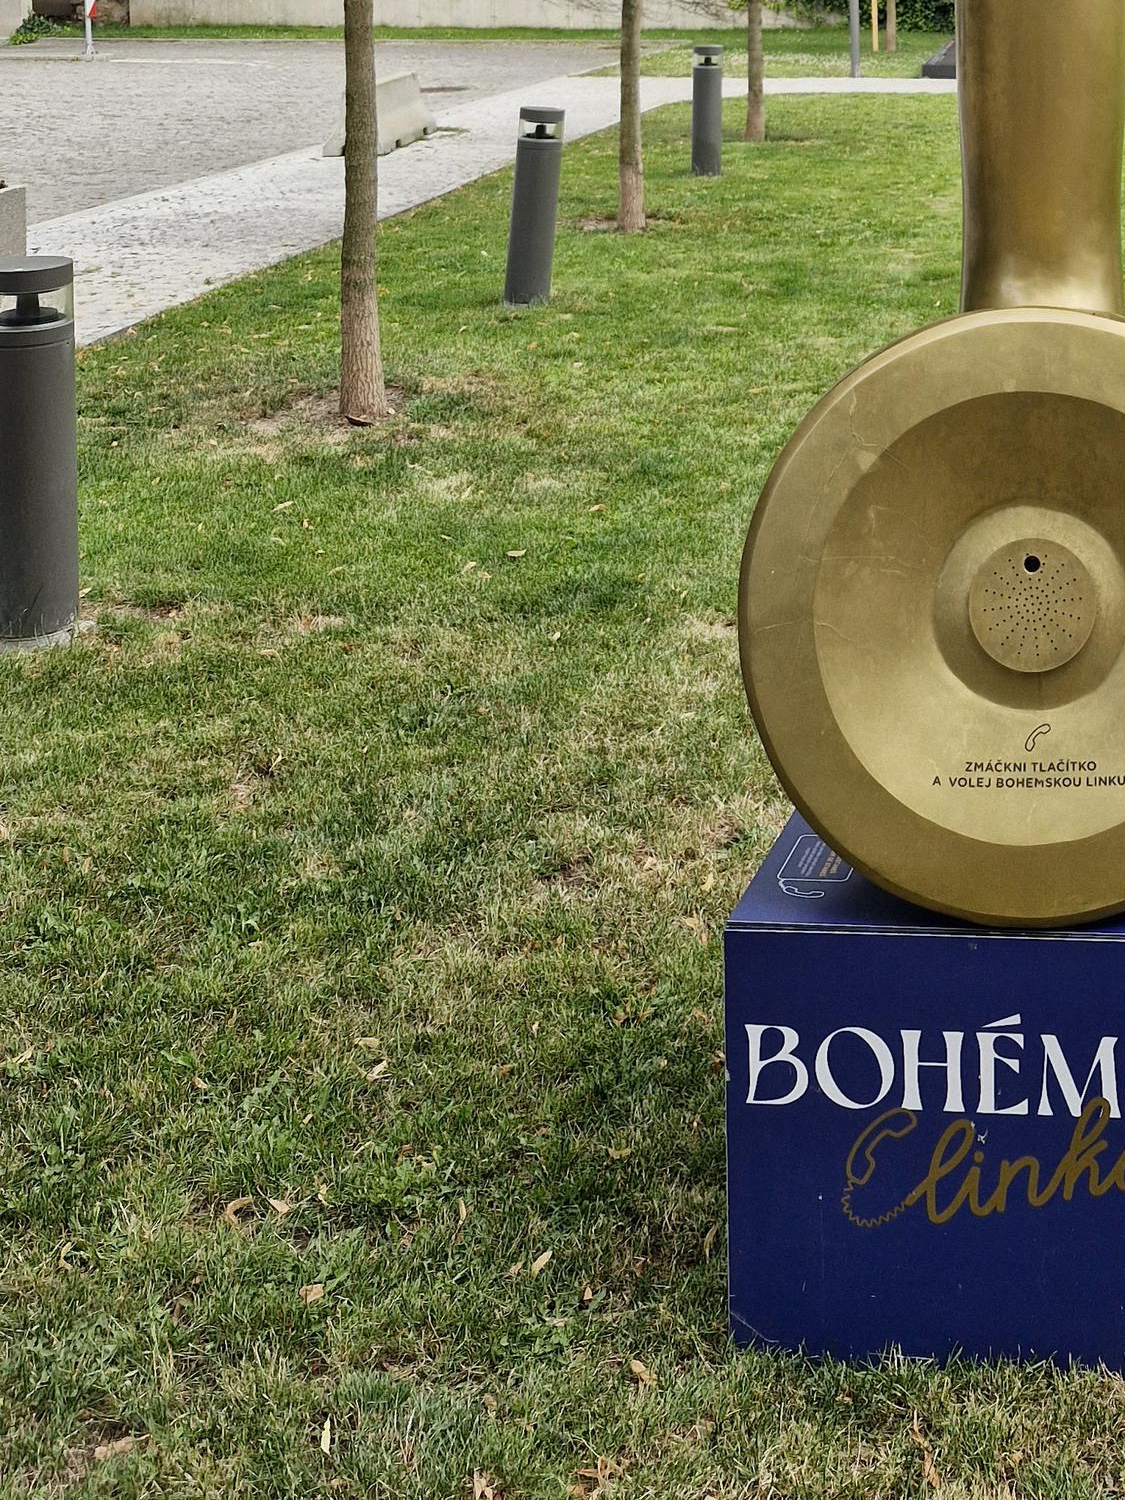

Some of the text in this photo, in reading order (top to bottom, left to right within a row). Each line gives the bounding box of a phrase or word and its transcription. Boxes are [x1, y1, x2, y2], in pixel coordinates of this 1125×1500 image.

[964, 759, 1098, 773] ZMÁČKNI TLAČÍTKO
[932, 775, 942, 787] A
[949, 776, 992, 789] VOLEJ
